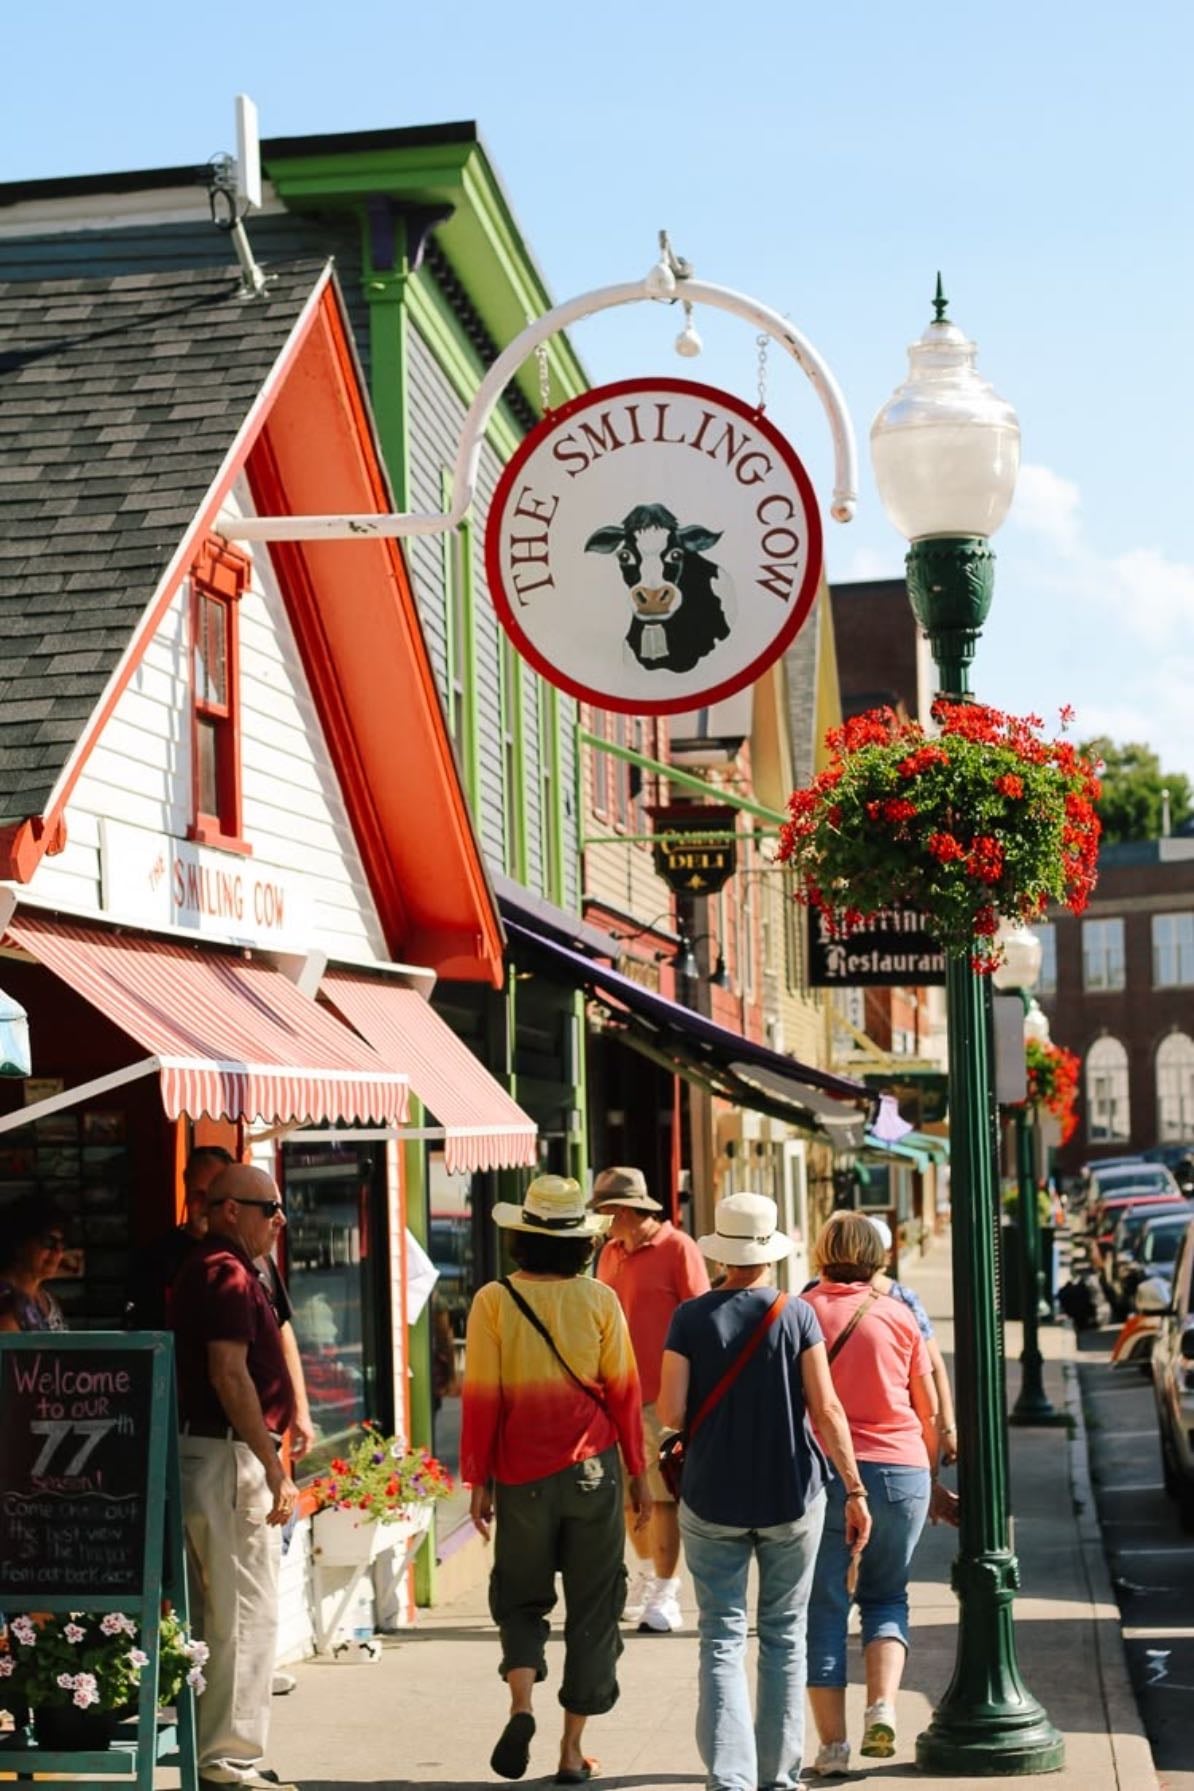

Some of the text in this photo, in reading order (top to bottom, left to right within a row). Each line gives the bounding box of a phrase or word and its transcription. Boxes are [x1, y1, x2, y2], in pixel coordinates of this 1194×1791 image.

[510, 403, 800, 607] THE SMILING COW
[668, 853, 725, 870] DELI
[172, 857, 245, 921] SMILING
[254, 880, 285, 930] COW
[825, 944, 946, 977] Restauran
[11, 1352, 131, 1396] Welcome
[35, 1397, 65, 1419] to
